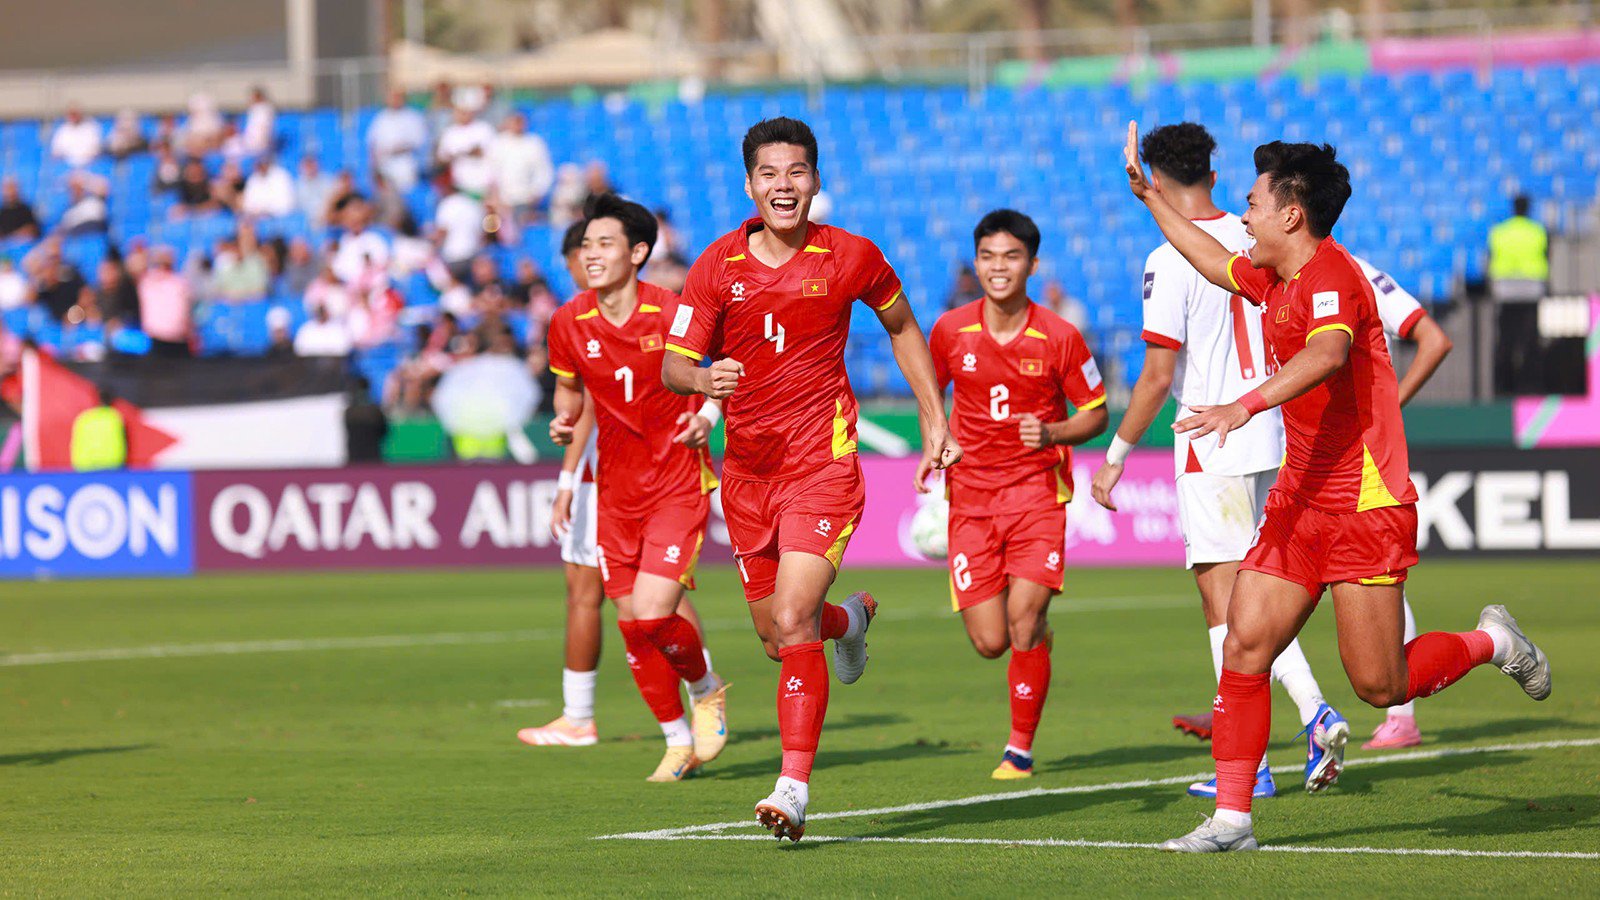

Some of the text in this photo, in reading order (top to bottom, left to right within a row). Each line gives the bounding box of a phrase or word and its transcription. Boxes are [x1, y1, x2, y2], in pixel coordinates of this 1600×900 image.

[764, 313, 785, 353] 4
[614, 365, 633, 403] 7
[989, 383, 1010, 421] 2
[0, 482, 179, 561] ISON
[209, 482, 441, 559] QATAR
[953, 552, 972, 592] 2
